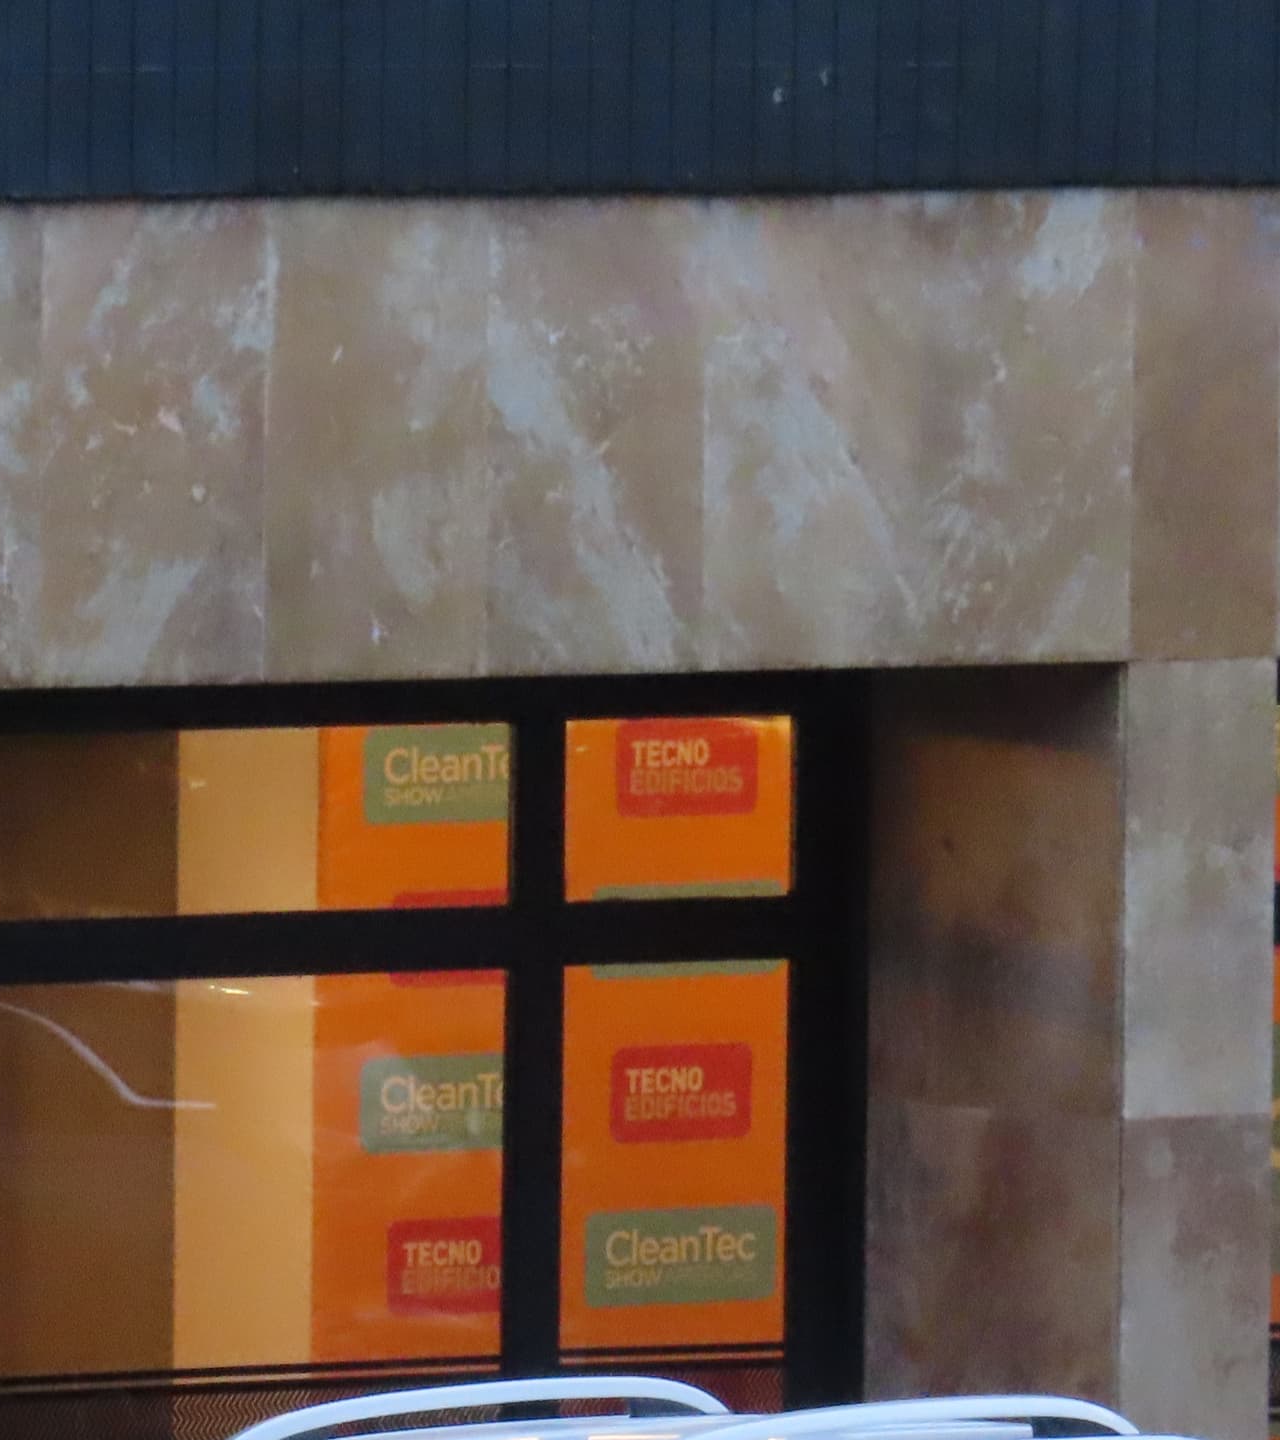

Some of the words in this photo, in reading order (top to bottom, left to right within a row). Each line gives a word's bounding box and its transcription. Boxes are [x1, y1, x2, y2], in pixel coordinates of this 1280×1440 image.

[384, 744, 510, 785] CleanT
[632, 738, 710, 767] TECNO
[381, 1072, 504, 1114] CleanT
[625, 1066, 704, 1095] TECNO
[625, 1090, 737, 1122] EDIFICIOS
[403, 1239, 482, 1267] TECNO
[606, 1226, 756, 1267] CleanTec
[402, 1264, 501, 1295] EDIFICIO
